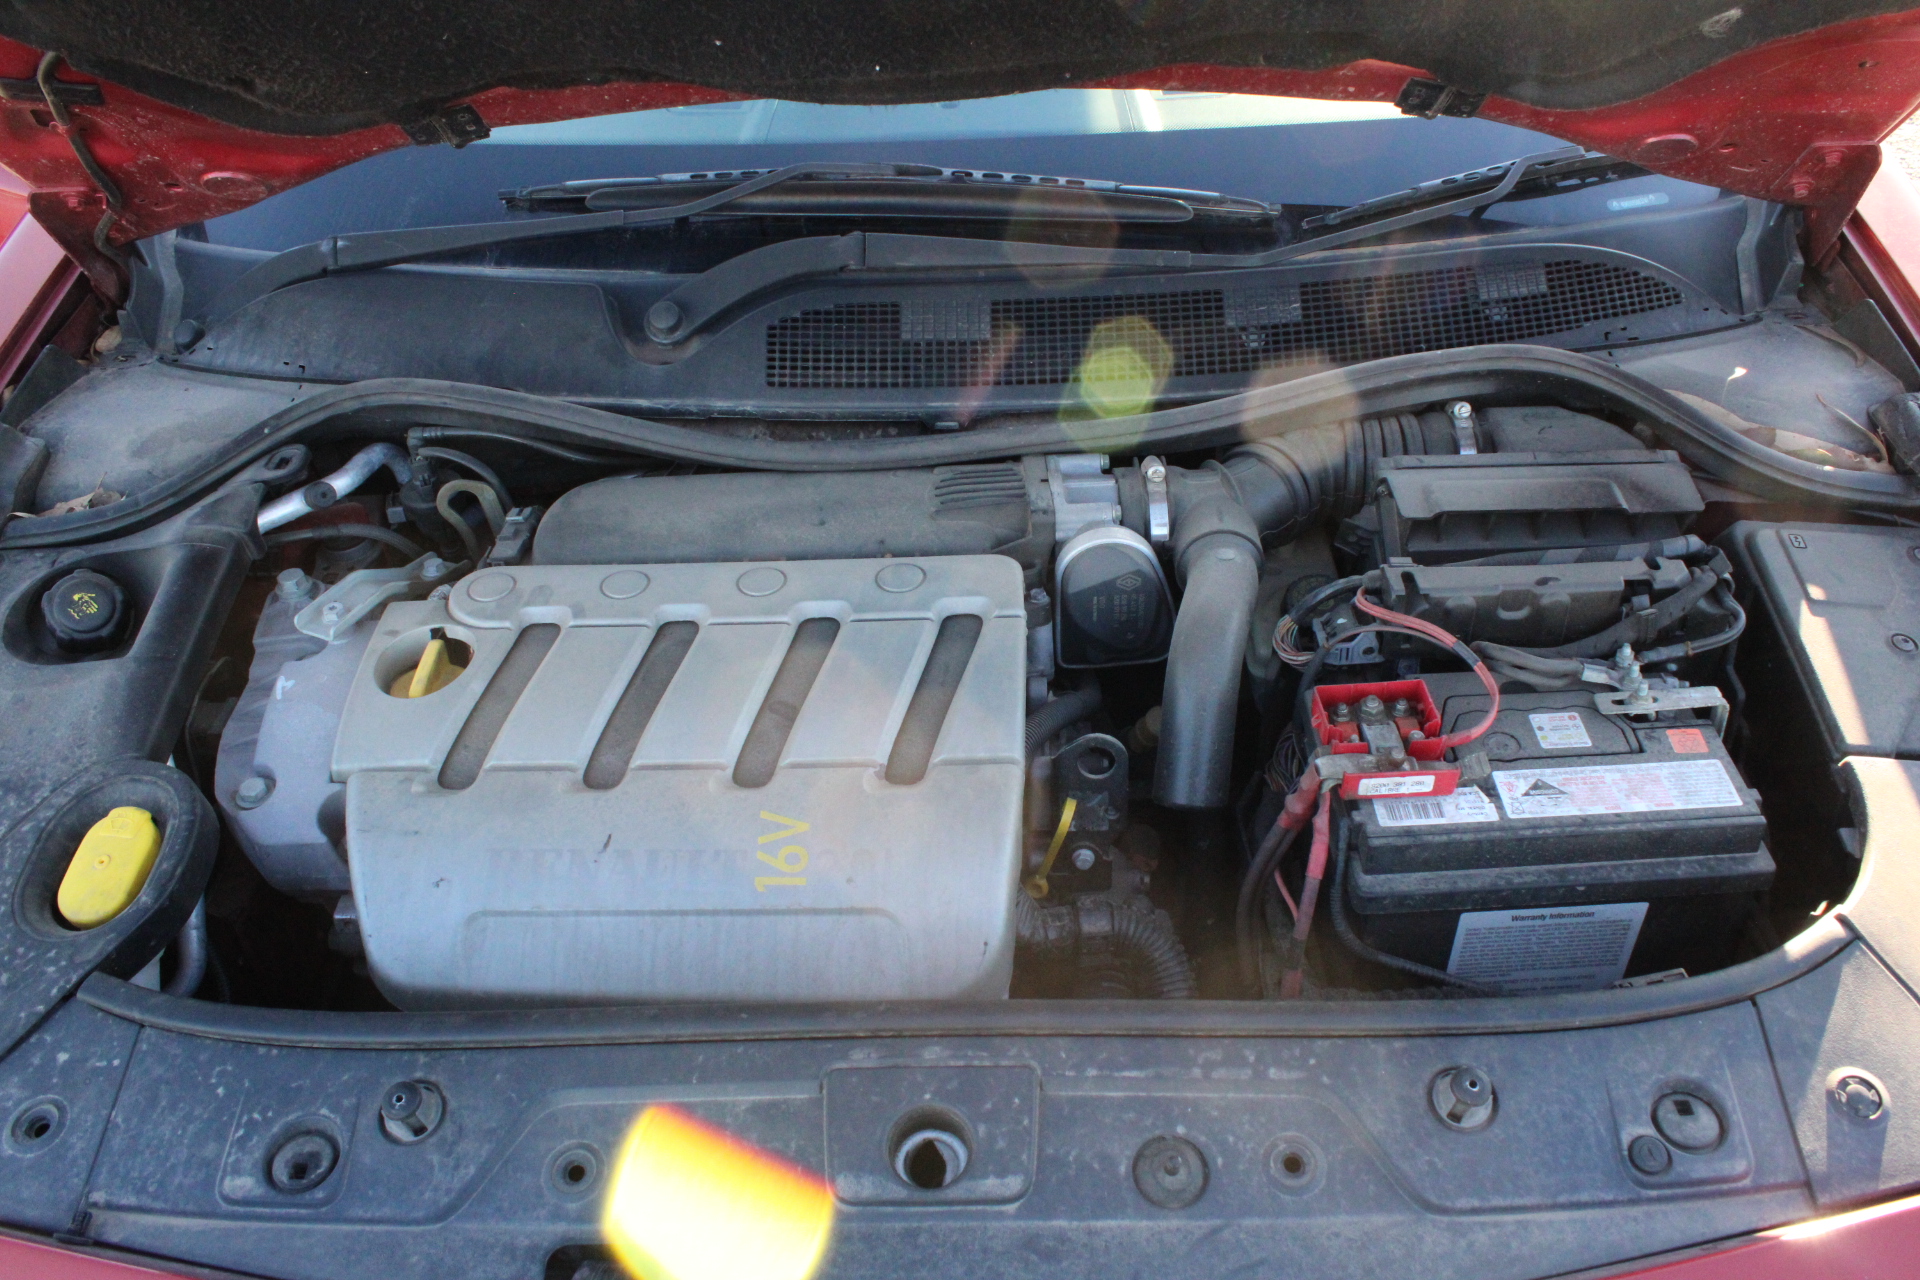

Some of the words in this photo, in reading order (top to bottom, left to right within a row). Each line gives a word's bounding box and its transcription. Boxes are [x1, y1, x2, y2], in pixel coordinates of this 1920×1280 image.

[754, 810, 810, 892] 16V
[1511, 913, 1547, 922] Warranty
[1549, 911, 1595, 920] Information
